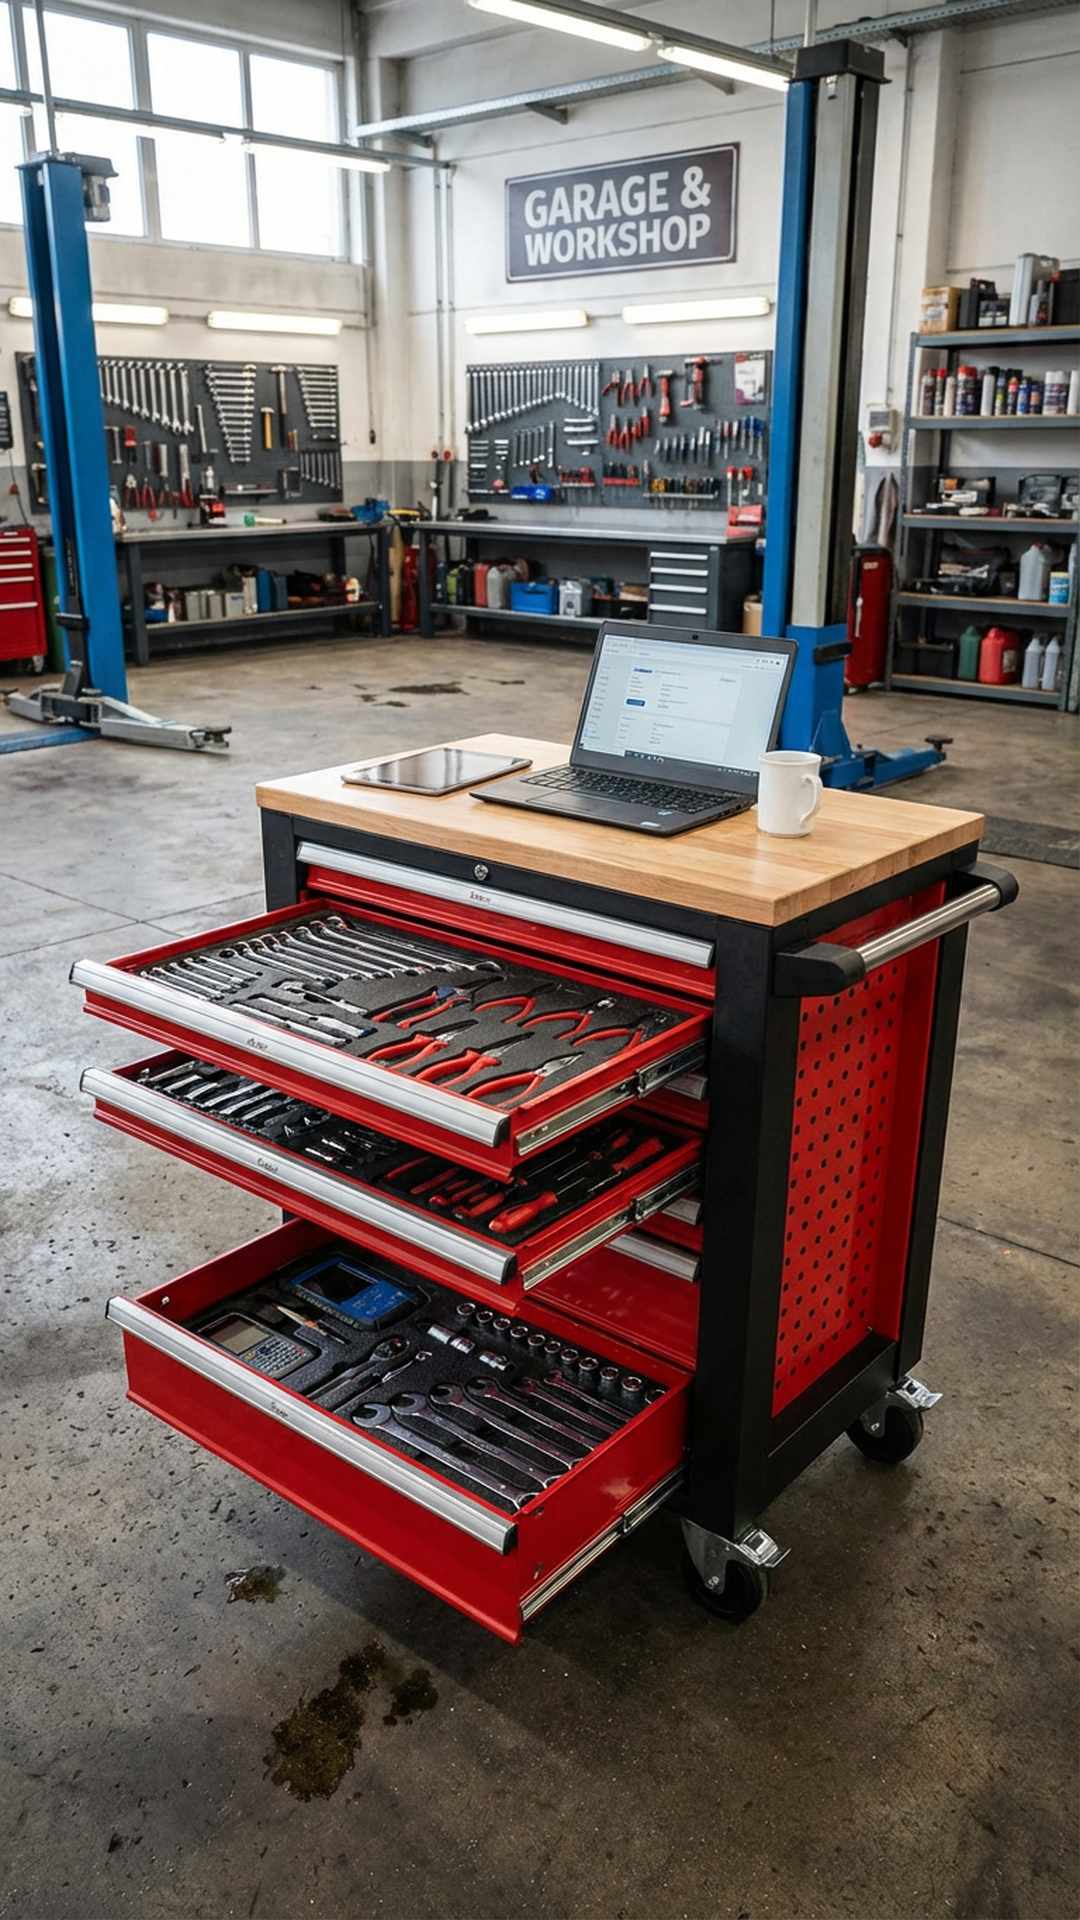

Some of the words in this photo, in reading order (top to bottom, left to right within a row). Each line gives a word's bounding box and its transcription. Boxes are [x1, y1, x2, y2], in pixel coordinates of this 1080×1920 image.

[524, 171, 669, 229] GARAGE
[680, 165, 711, 209] &
[524, 213, 711, 266] WORKSHOP
